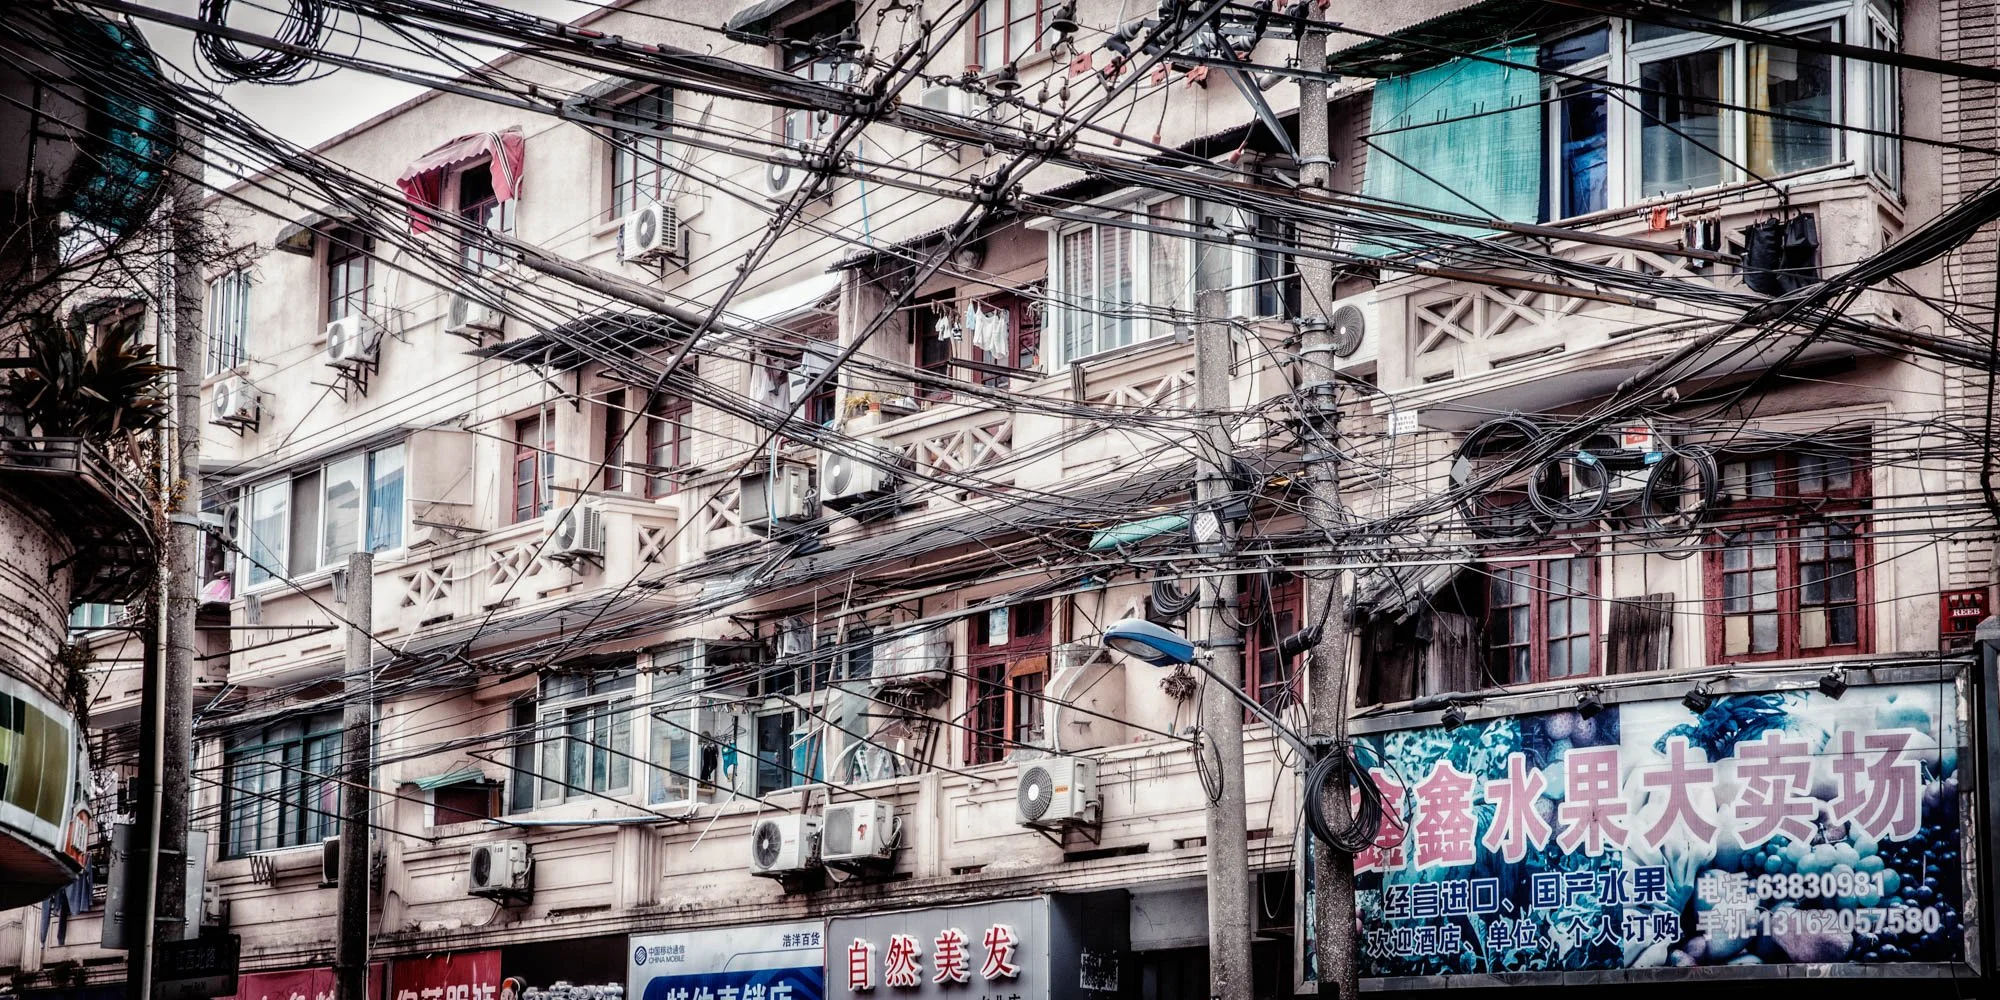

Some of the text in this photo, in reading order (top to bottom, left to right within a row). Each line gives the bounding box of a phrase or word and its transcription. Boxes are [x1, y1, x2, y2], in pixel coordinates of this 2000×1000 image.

[1953, 608, 1980, 616] REEB
[1384, 866, 1667, 920] 经营进口、国产水果
[1696, 871, 1886, 904] 电话:63830981
[782, 932, 820, 947] 浩洋百货
[1367, 912, 1682, 958] 欢迎酒店、单位、个人订购
[1696, 906, 1941, 941] 手机:13162057580
[648, 945, 685, 957] 中国移动通信
[648, 955, 685, 964] CHINA MOBILE
[848, 924, 1018, 991] 自然美发
